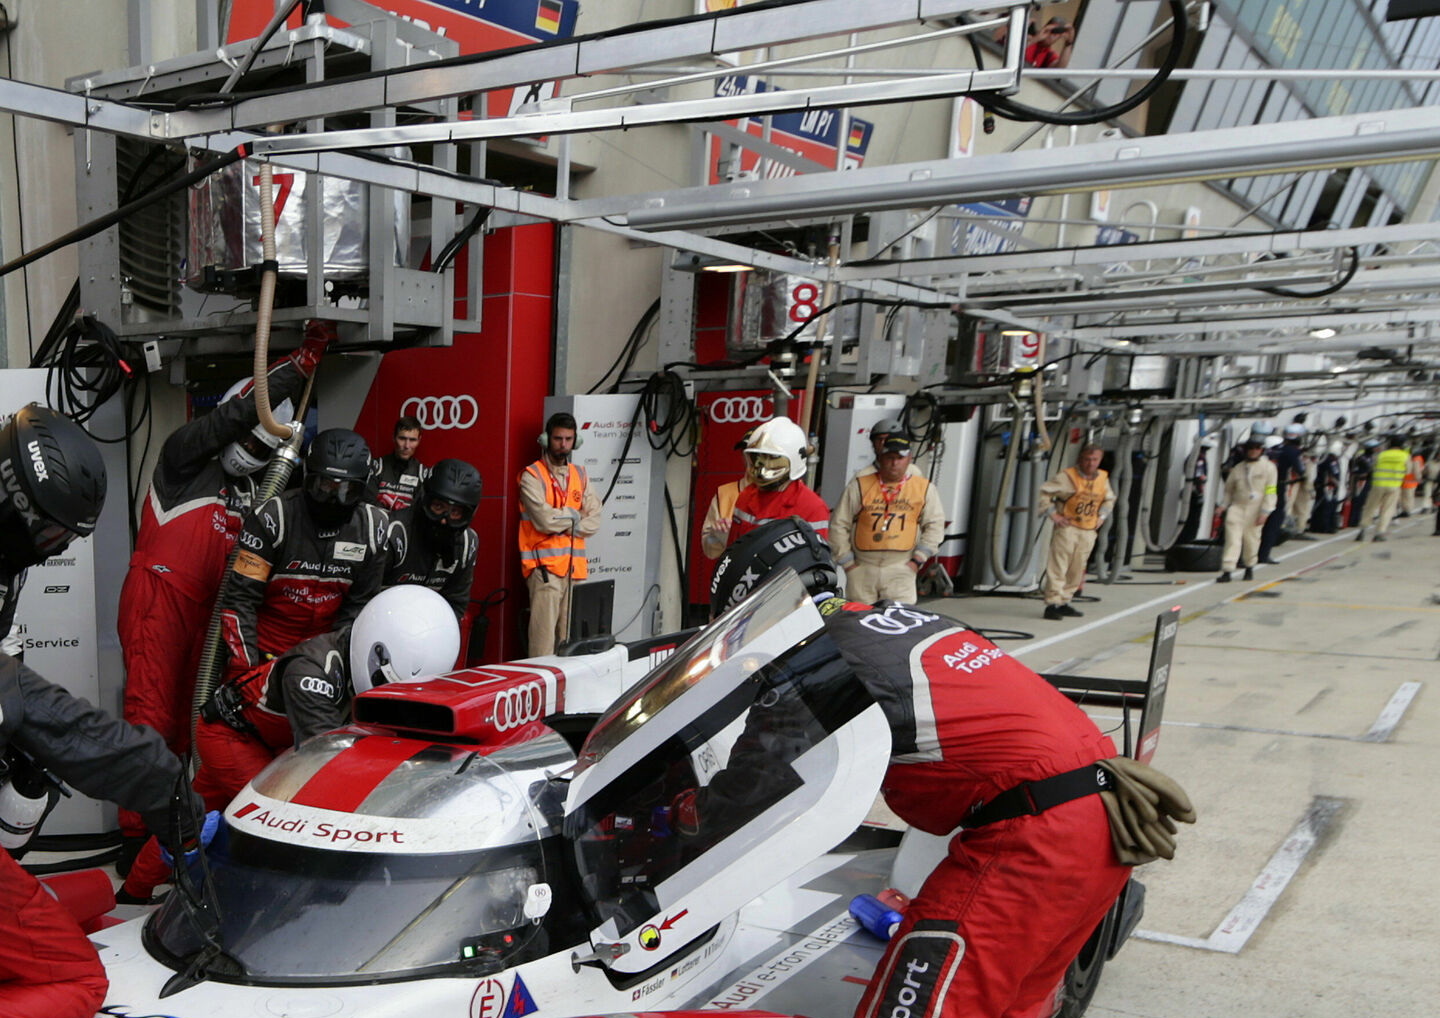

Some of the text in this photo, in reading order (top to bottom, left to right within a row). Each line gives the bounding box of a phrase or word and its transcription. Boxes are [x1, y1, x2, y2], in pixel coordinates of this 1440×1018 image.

[789, 283, 819, 323] 8
[27, 440, 49, 482] uvex
[0, 458, 40, 527] uvex
[586, 556, 601, 565] udi
[599, 565, 632, 574] Service
[710, 555, 732, 595] uvex
[26, 638, 80, 649] Service
[955, 654, 992, 674] Top
[252, 812, 407, 845] Audi Sport
[711, 980, 762, 1010] Audi
[756, 946, 810, 984] e-tron
